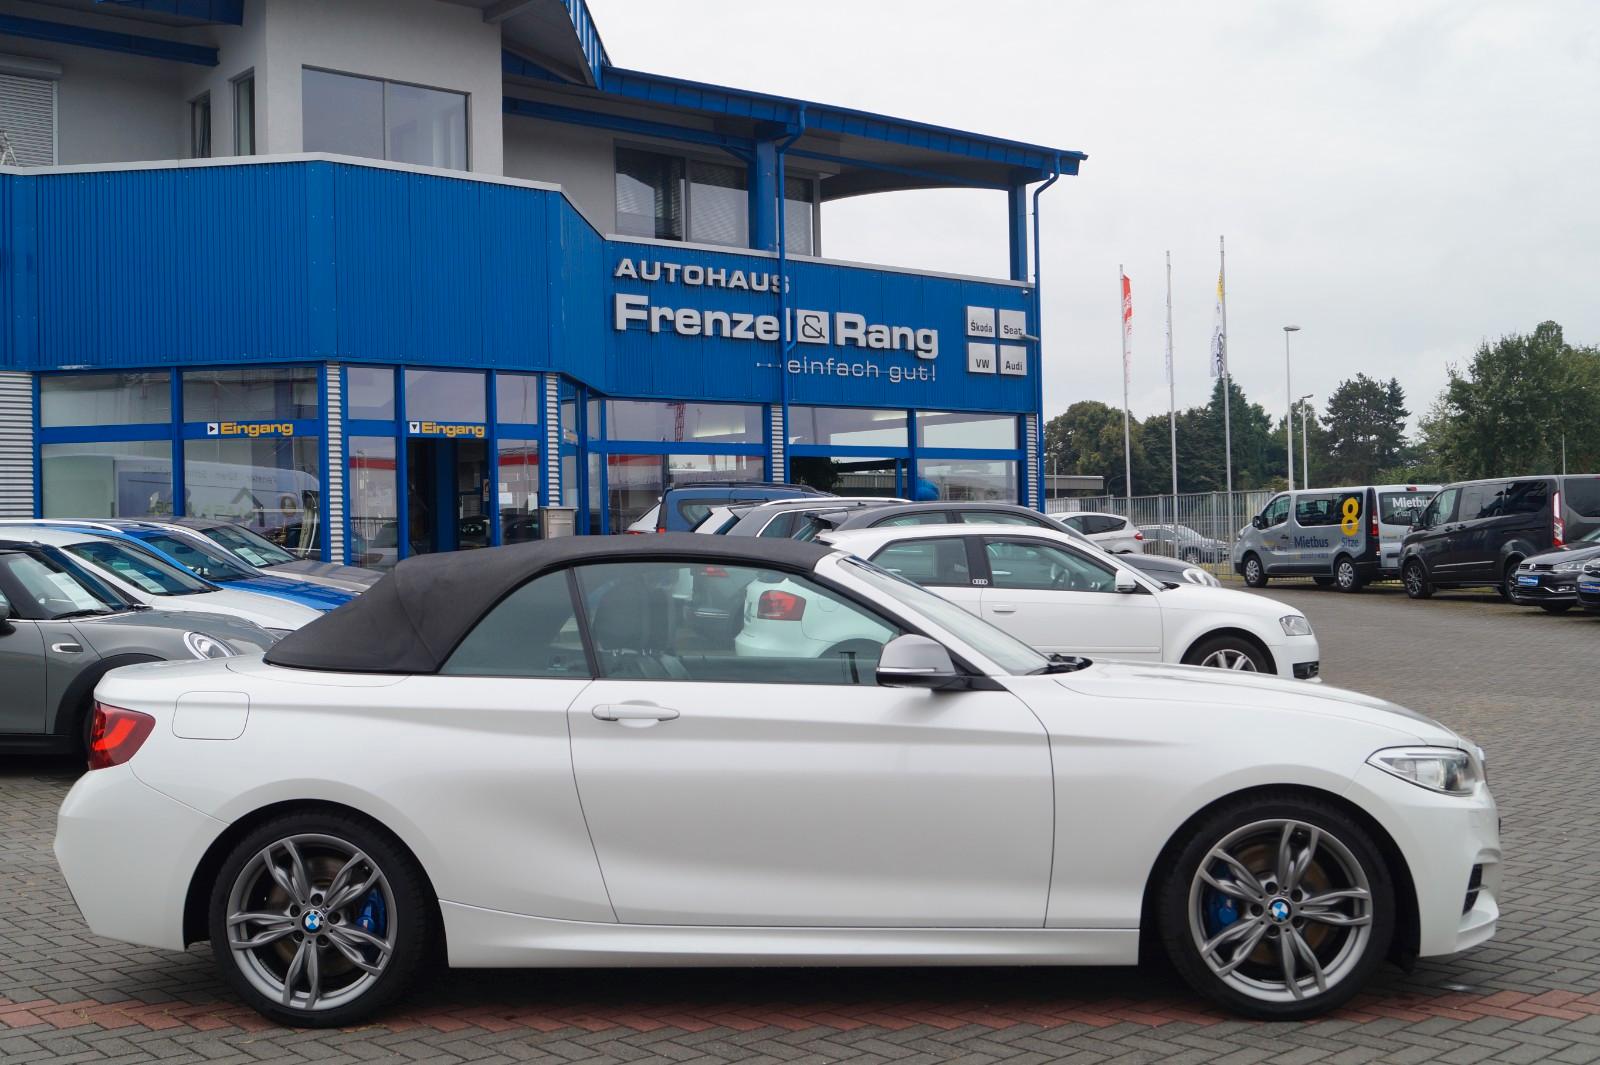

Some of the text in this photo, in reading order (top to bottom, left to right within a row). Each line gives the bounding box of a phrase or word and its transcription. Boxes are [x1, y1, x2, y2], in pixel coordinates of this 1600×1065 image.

[614, 258, 790, 295] AUTOHAUS
[615, 293, 939, 360] Frenzel & Rang
[1003, 325, 1023, 336] Seat
[976, 359, 990, 369] VW
[1005, 361, 1023, 371] Audi
[889, 364, 936, 383] gut!
[220, 422, 294, 438] Eingang
[421, 421, 485, 438] Eingang
[1341, 496, 1359, 537] 8
[1294, 536, 1329, 548] Mietbus
[1341, 536, 1359, 548] Sitze
